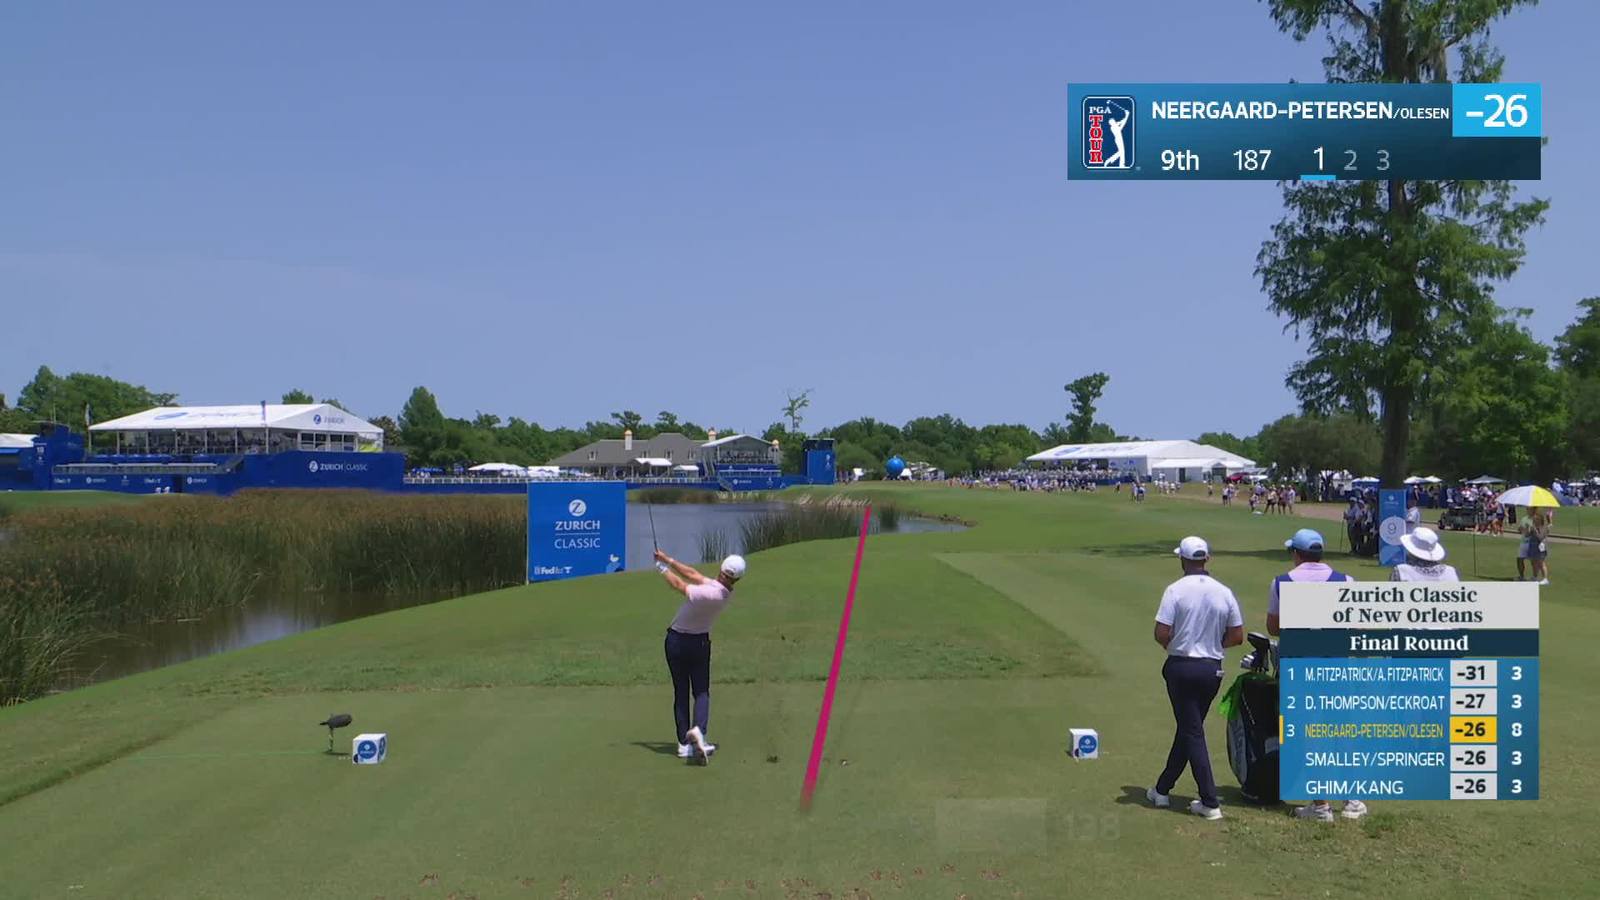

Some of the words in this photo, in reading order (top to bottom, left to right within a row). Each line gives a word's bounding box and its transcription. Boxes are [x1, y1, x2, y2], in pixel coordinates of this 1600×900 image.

[320, 463, 344, 471] ZURICH
[345, 463, 369, 471] CLASSIC
[555, 520, 601, 530] ZURICH
[1388, 522, 1396, 535] 9
[554, 538, 601, 549] CLASSIC
